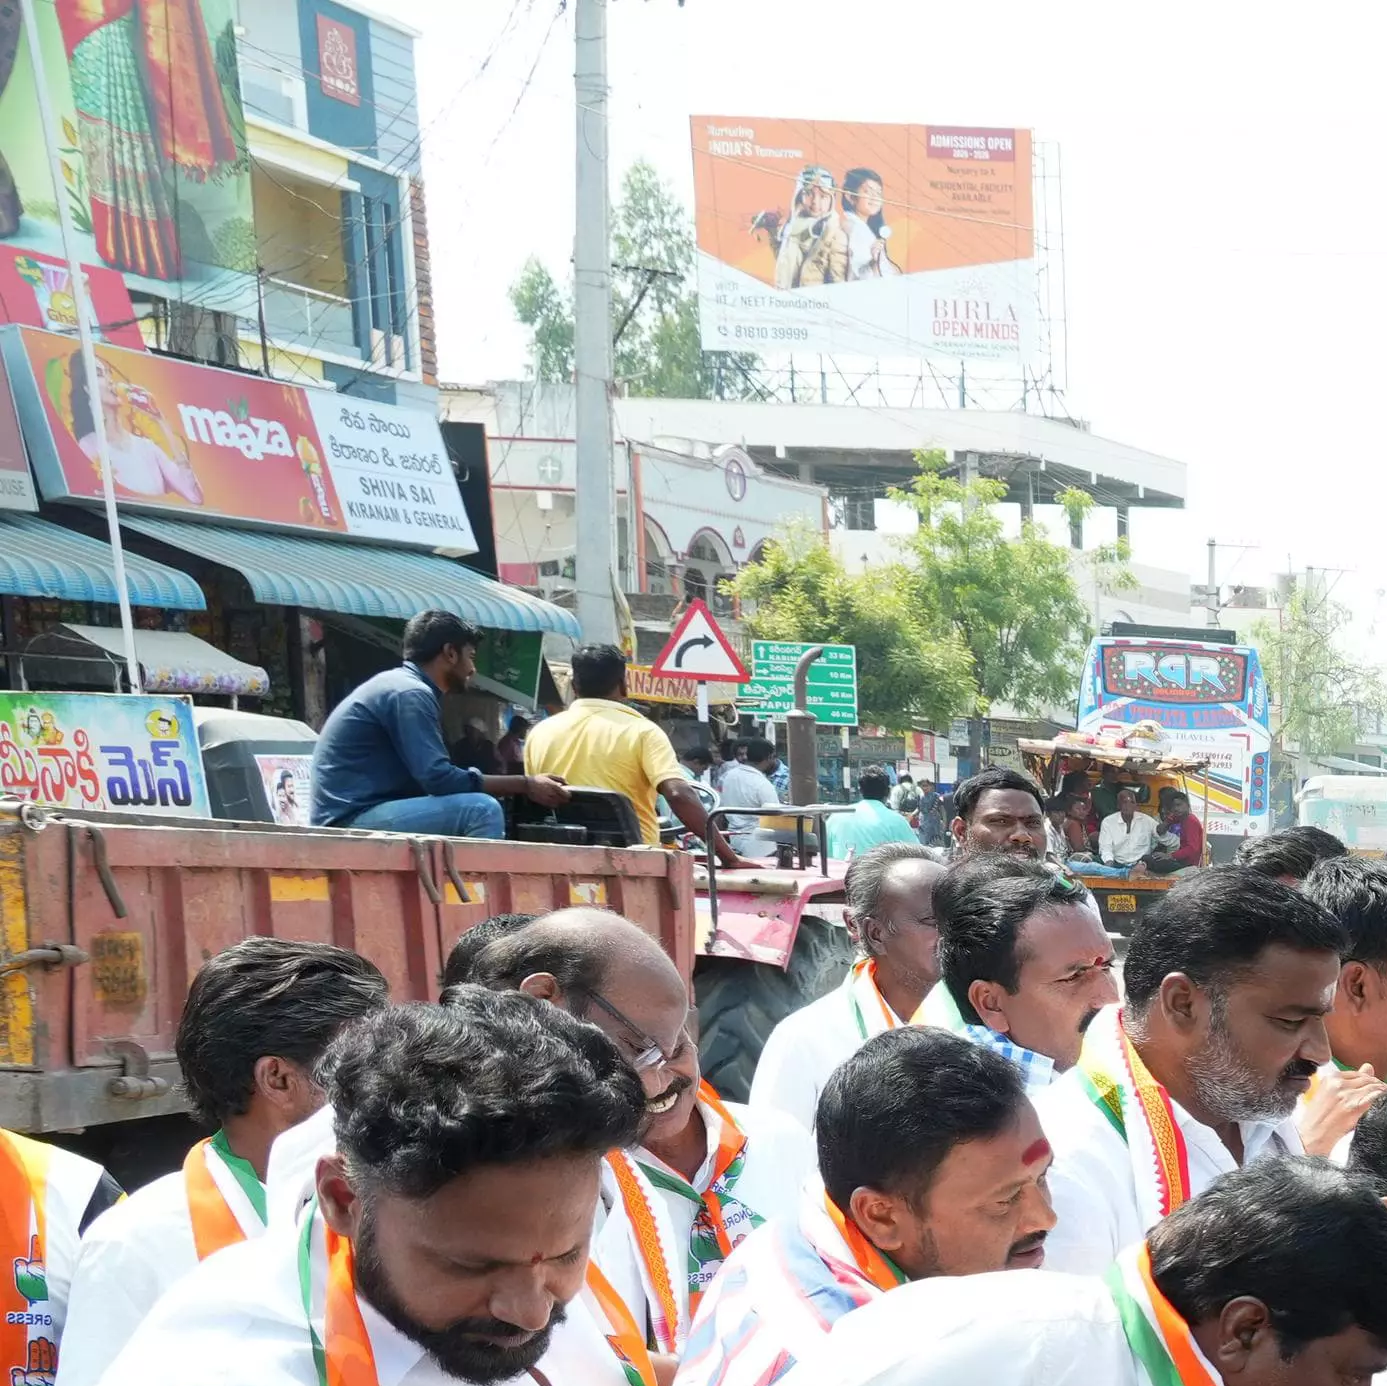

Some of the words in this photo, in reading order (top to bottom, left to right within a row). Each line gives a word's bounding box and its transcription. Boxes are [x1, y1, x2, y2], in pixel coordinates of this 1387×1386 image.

[930, 134, 985, 149] ADMISSIONS
[988, 138, 1012, 150] OPEN
[741, 295, 767, 307] NEET
[769, 297, 829, 309] Foundation
[933, 299, 1019, 322] BIRLA
[933, 320, 970, 338] OPEN
[974, 322, 1020, 341] MINDS
[177, 403, 295, 461] maaza
[383, 450, 395, 469] &
[359, 476, 406, 503] SHIVA
[411, 485, 437, 507] SAI
[348, 502, 400, 524] KIRANAM
[403, 513, 411, 526] &
[413, 511, 466, 533] GENERAL
[100, 740, 193, 807] మెస్
